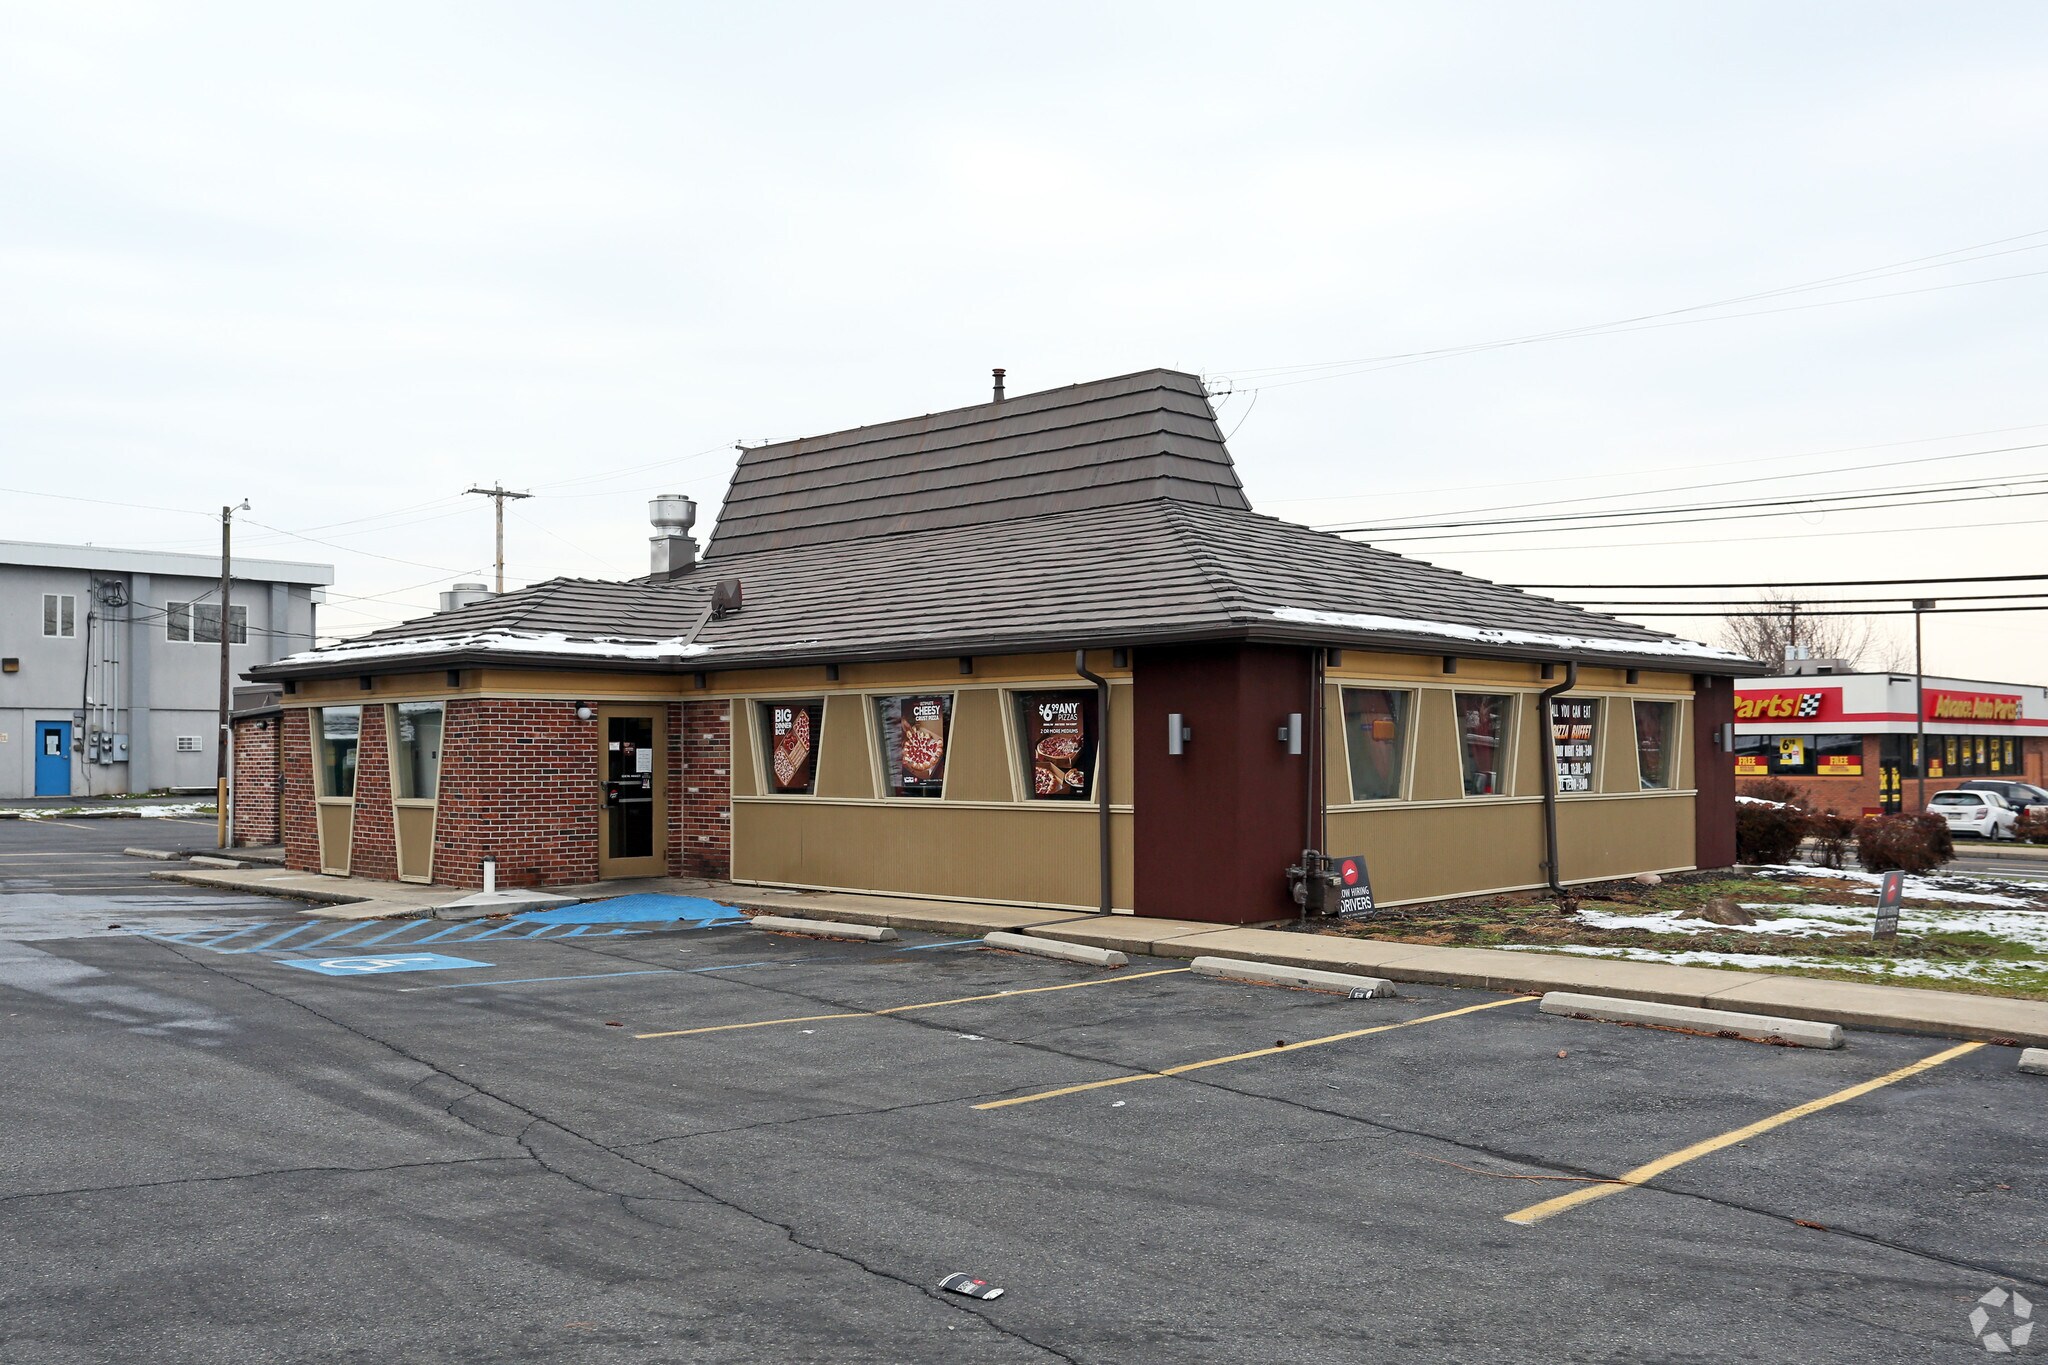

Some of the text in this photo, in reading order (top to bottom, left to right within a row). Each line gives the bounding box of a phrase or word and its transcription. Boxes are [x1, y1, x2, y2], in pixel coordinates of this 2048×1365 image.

[913, 705, 940, 716] CHEESY
[1059, 703, 1078, 714] ANY
[1561, 704, 1570, 718] YOU
[1572, 705, 1581, 718] CAN
[1583, 705, 1591, 718] EAT
[1734, 695, 1794, 718] Parts
[1935, 694, 2016, 720] Advance Auto Parts
[775, 709, 792, 722] BIG
[1553, 724, 1592, 740] PIZZA BUFFET
[1738, 756, 1756, 765] FREE
[1829, 756, 1849, 765] FREE
[1341, 886, 1369, 898] OW HIRING
[1341, 897, 1371, 912] DRIVERS
